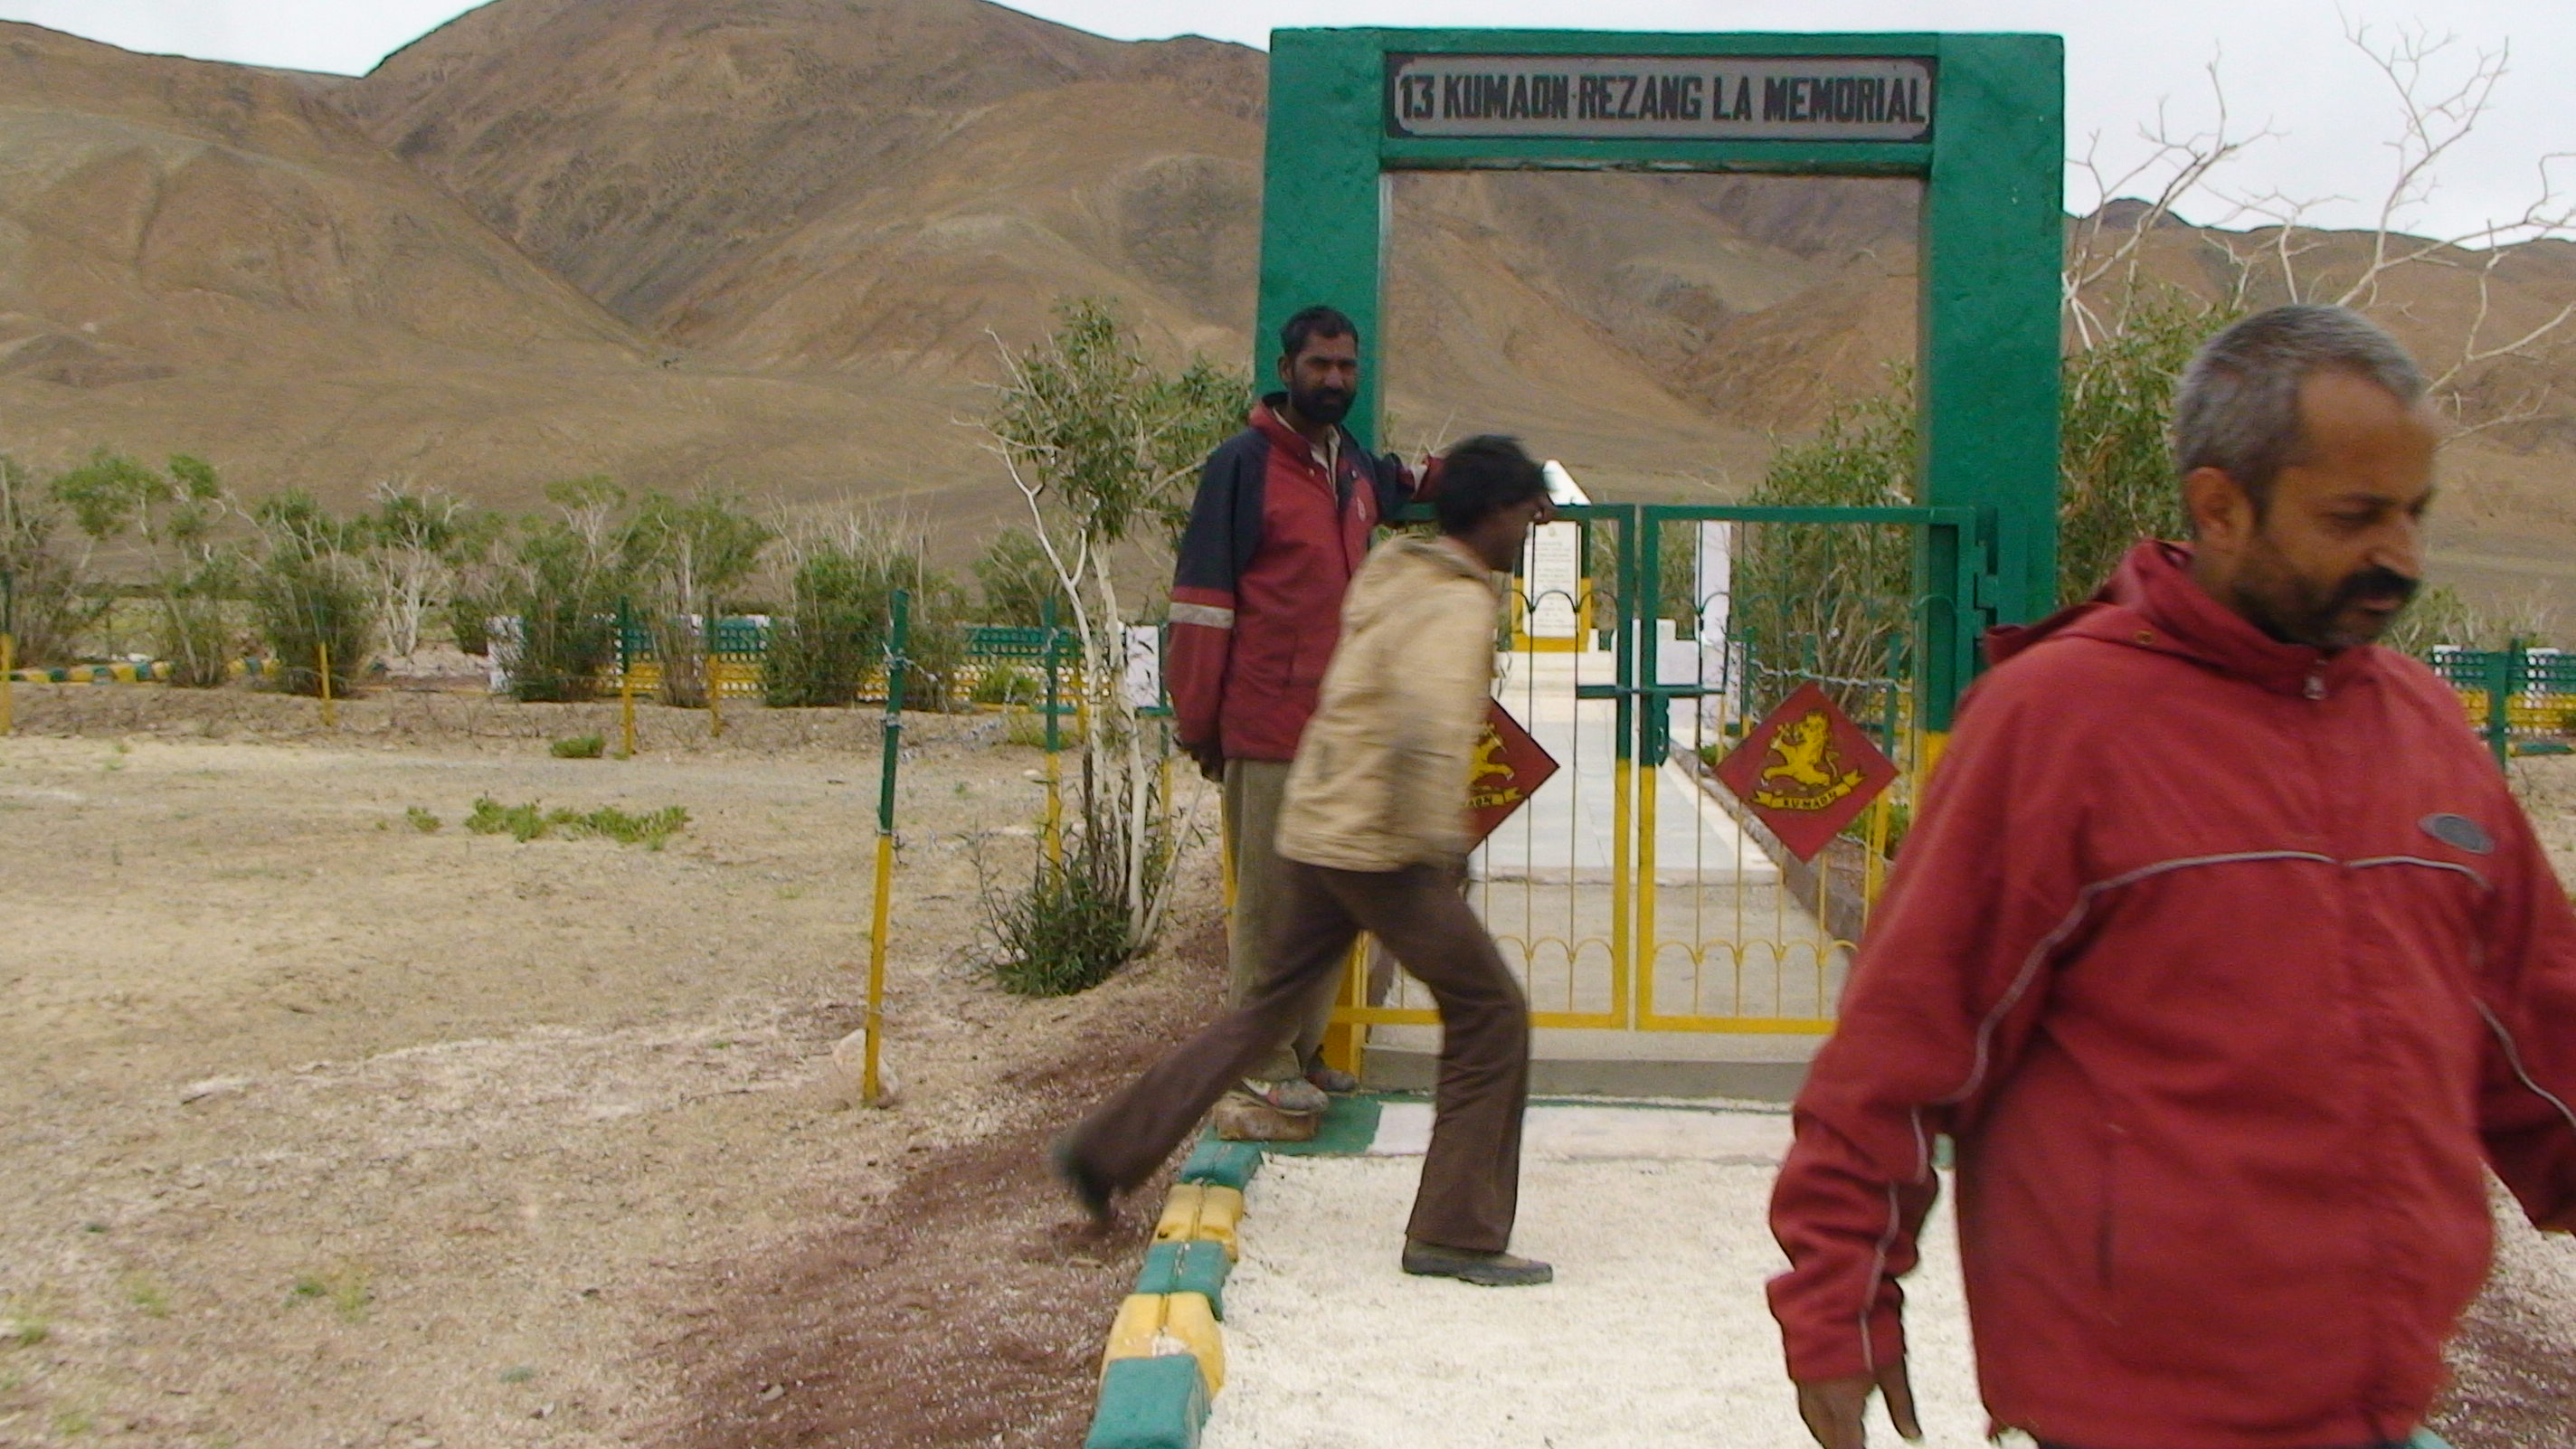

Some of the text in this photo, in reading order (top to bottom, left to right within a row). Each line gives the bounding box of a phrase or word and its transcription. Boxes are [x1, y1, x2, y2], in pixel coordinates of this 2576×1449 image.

[1401, 74, 1435, 118] 13
[1713, 76, 1752, 121] LA
[1764, 76, 1927, 123] MEMORIAL
